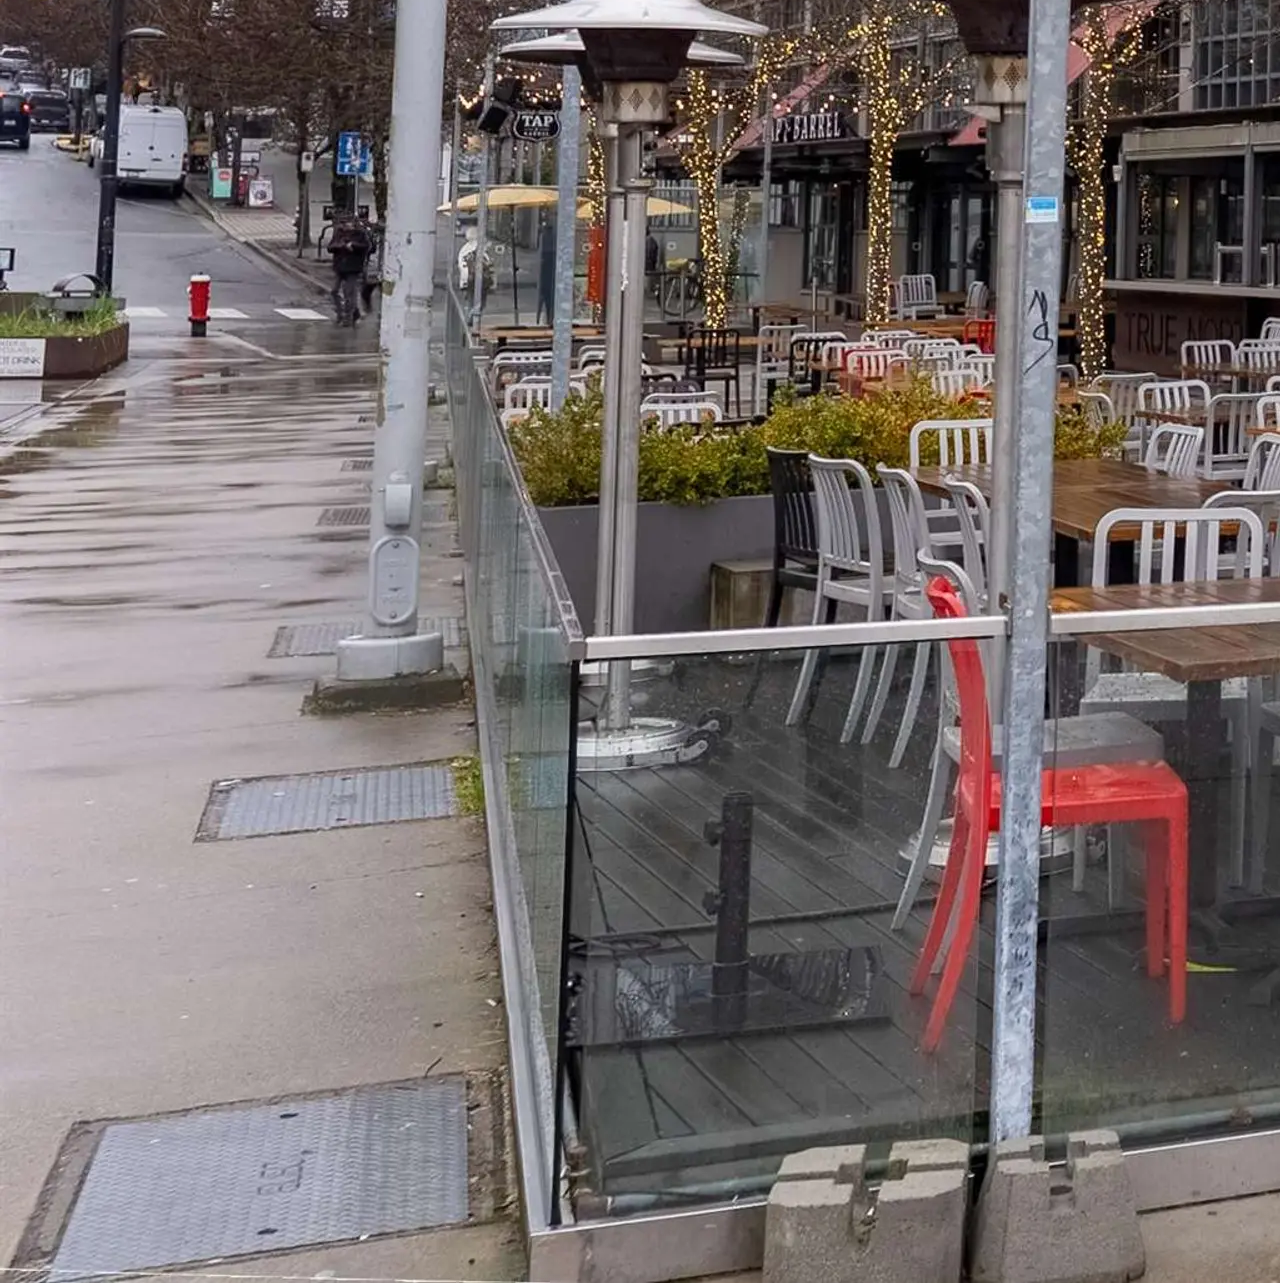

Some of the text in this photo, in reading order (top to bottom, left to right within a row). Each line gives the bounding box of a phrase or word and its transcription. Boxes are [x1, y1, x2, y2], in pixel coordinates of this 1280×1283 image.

[522, 115, 553, 127] TAP
[793, 112, 841, 140] BARREL
[1124, 312, 1178, 356] TRUE
